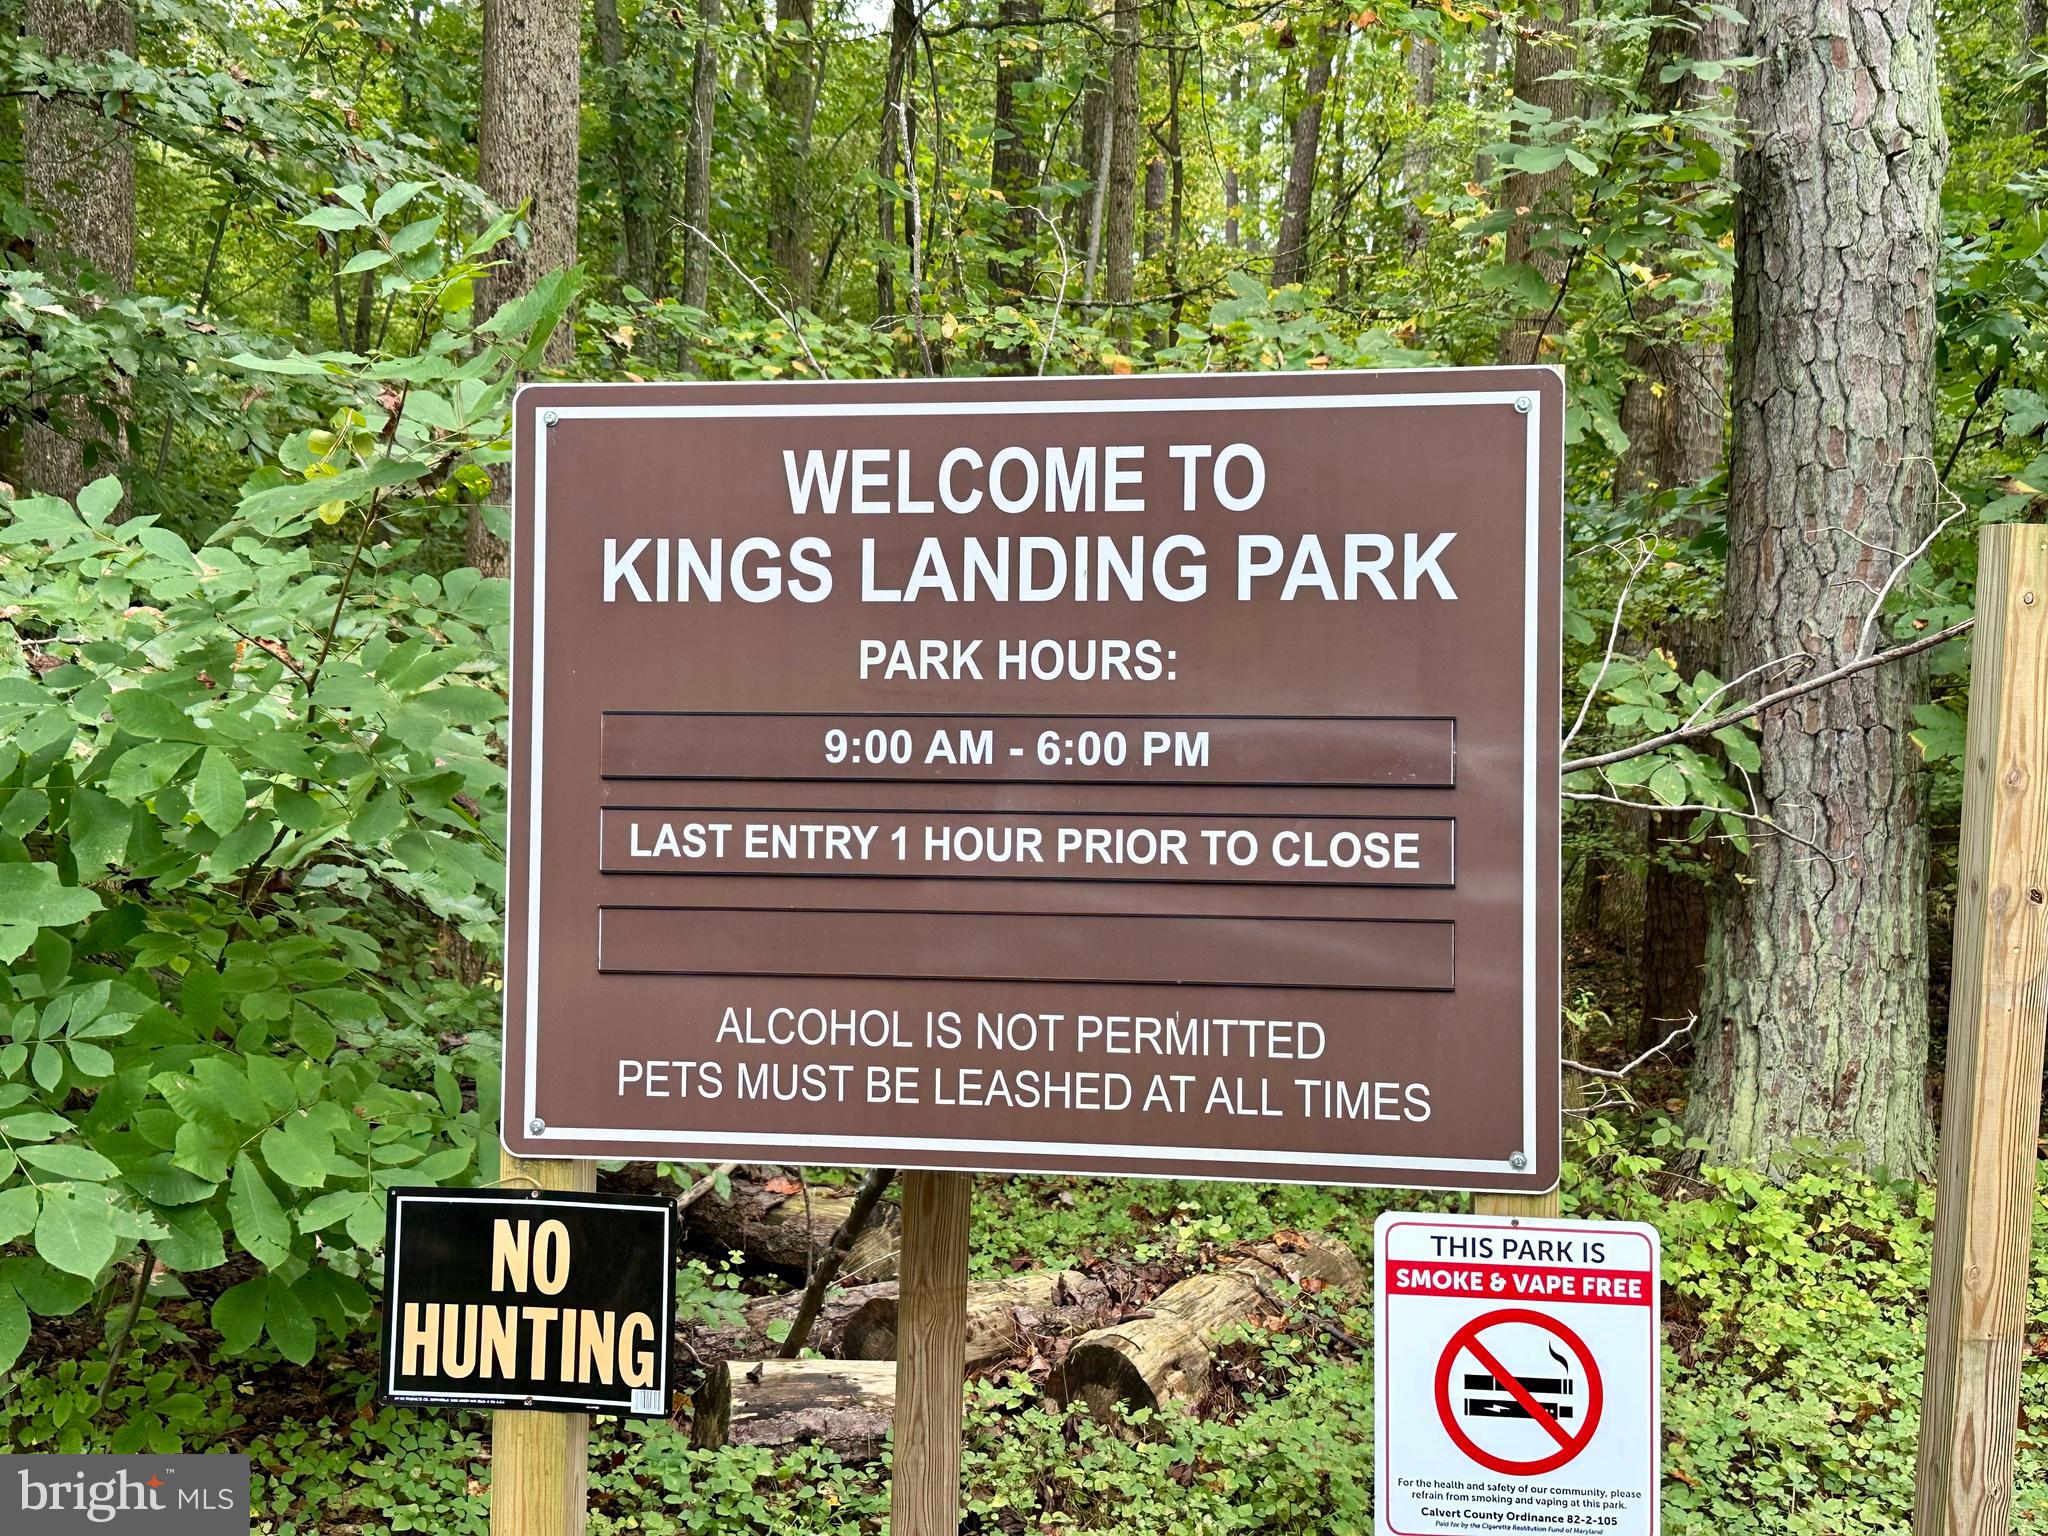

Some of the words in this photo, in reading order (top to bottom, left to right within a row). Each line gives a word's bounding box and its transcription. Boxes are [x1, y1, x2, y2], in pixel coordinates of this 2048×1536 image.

[783, 446, 1144, 514] WELCOME
[1169, 444, 1265, 511] TO
[604, 537, 832, 602] KINGS
[862, 535, 1206, 602] LANDING
[1238, 533, 1458, 600] PARK
[860, 640, 983, 679] PARK
[999, 640, 1176, 680] HOURS:
[825, 729, 912, 763] 9:00
[924, 730, 992, 764] AM
[1038, 731, 1126, 766] 6:00
[1144, 732, 1209, 766] PM
[631, 824, 732, 857] LAST
[746, 825, 878, 859] ENTRY
[892, 826, 905, 860] 1
[925, 827, 1043, 862] HOUR
[1058, 829, 1188, 864] PRIOR
[1201, 831, 1258, 865] TO
[1273, 831, 1419, 868] CLOSE
[716, 1007, 912, 1047] ALCOHOL
[927, 1012, 961, 1048] IS
[978, 1013, 1064, 1051] NOT
[1077, 1014, 1325, 1060] PERMITTED
[619, 1060, 722, 1098] PETS
[738, 1063, 853, 1101] MUST
[867, 1066, 919, 1103] BE
[936, 1068, 1131, 1110] LEASHED
[1143, 1075, 1195, 1112] AT
[1205, 1077, 1283, 1116] ALL
[1295, 1080, 1430, 1121] TIMES
[492, 1219, 570, 1295] NO
[1431, 1236, 1493, 1258] THIS
[1503, 1239, 1573, 1262] PARK
[1584, 1243, 1605, 1263] IS
[1397, 1269, 1483, 1290] SMOKE
[1490, 1273, 1506, 1291] &
[1512, 1274, 1575, 1295] VAPE
[1583, 1277, 1641, 1298] FREE
[402, 1303, 654, 1387] HUNTING
[1398, 1478, 1413, 1486] For
[1416, 1479, 1431, 1487] the
[1434, 1480, 1464, 1489] health
[1488, 1483, 1515, 1494] safety
[1550, 1488, 1607, 1498] community,
[1611, 1490, 1641, 1499] please
[1412, 1491, 1443, 1500] refrain
[1446, 1492, 1469, 1501] from
[1472, 1495, 1512, 1505] smoking
[1536, 1497, 1567, 1508] vaping
[1583, 1499, 1600, 1508] this
[1603, 1501, 1626, 1510] park.
[1421, 1507, 1460, 1518] Calvert
[1464, 1510, 1503, 1522] County
[1507, 1512, 1563, 1523] Ordinance
[1567, 1515, 1617, 1525] 82-2-105
